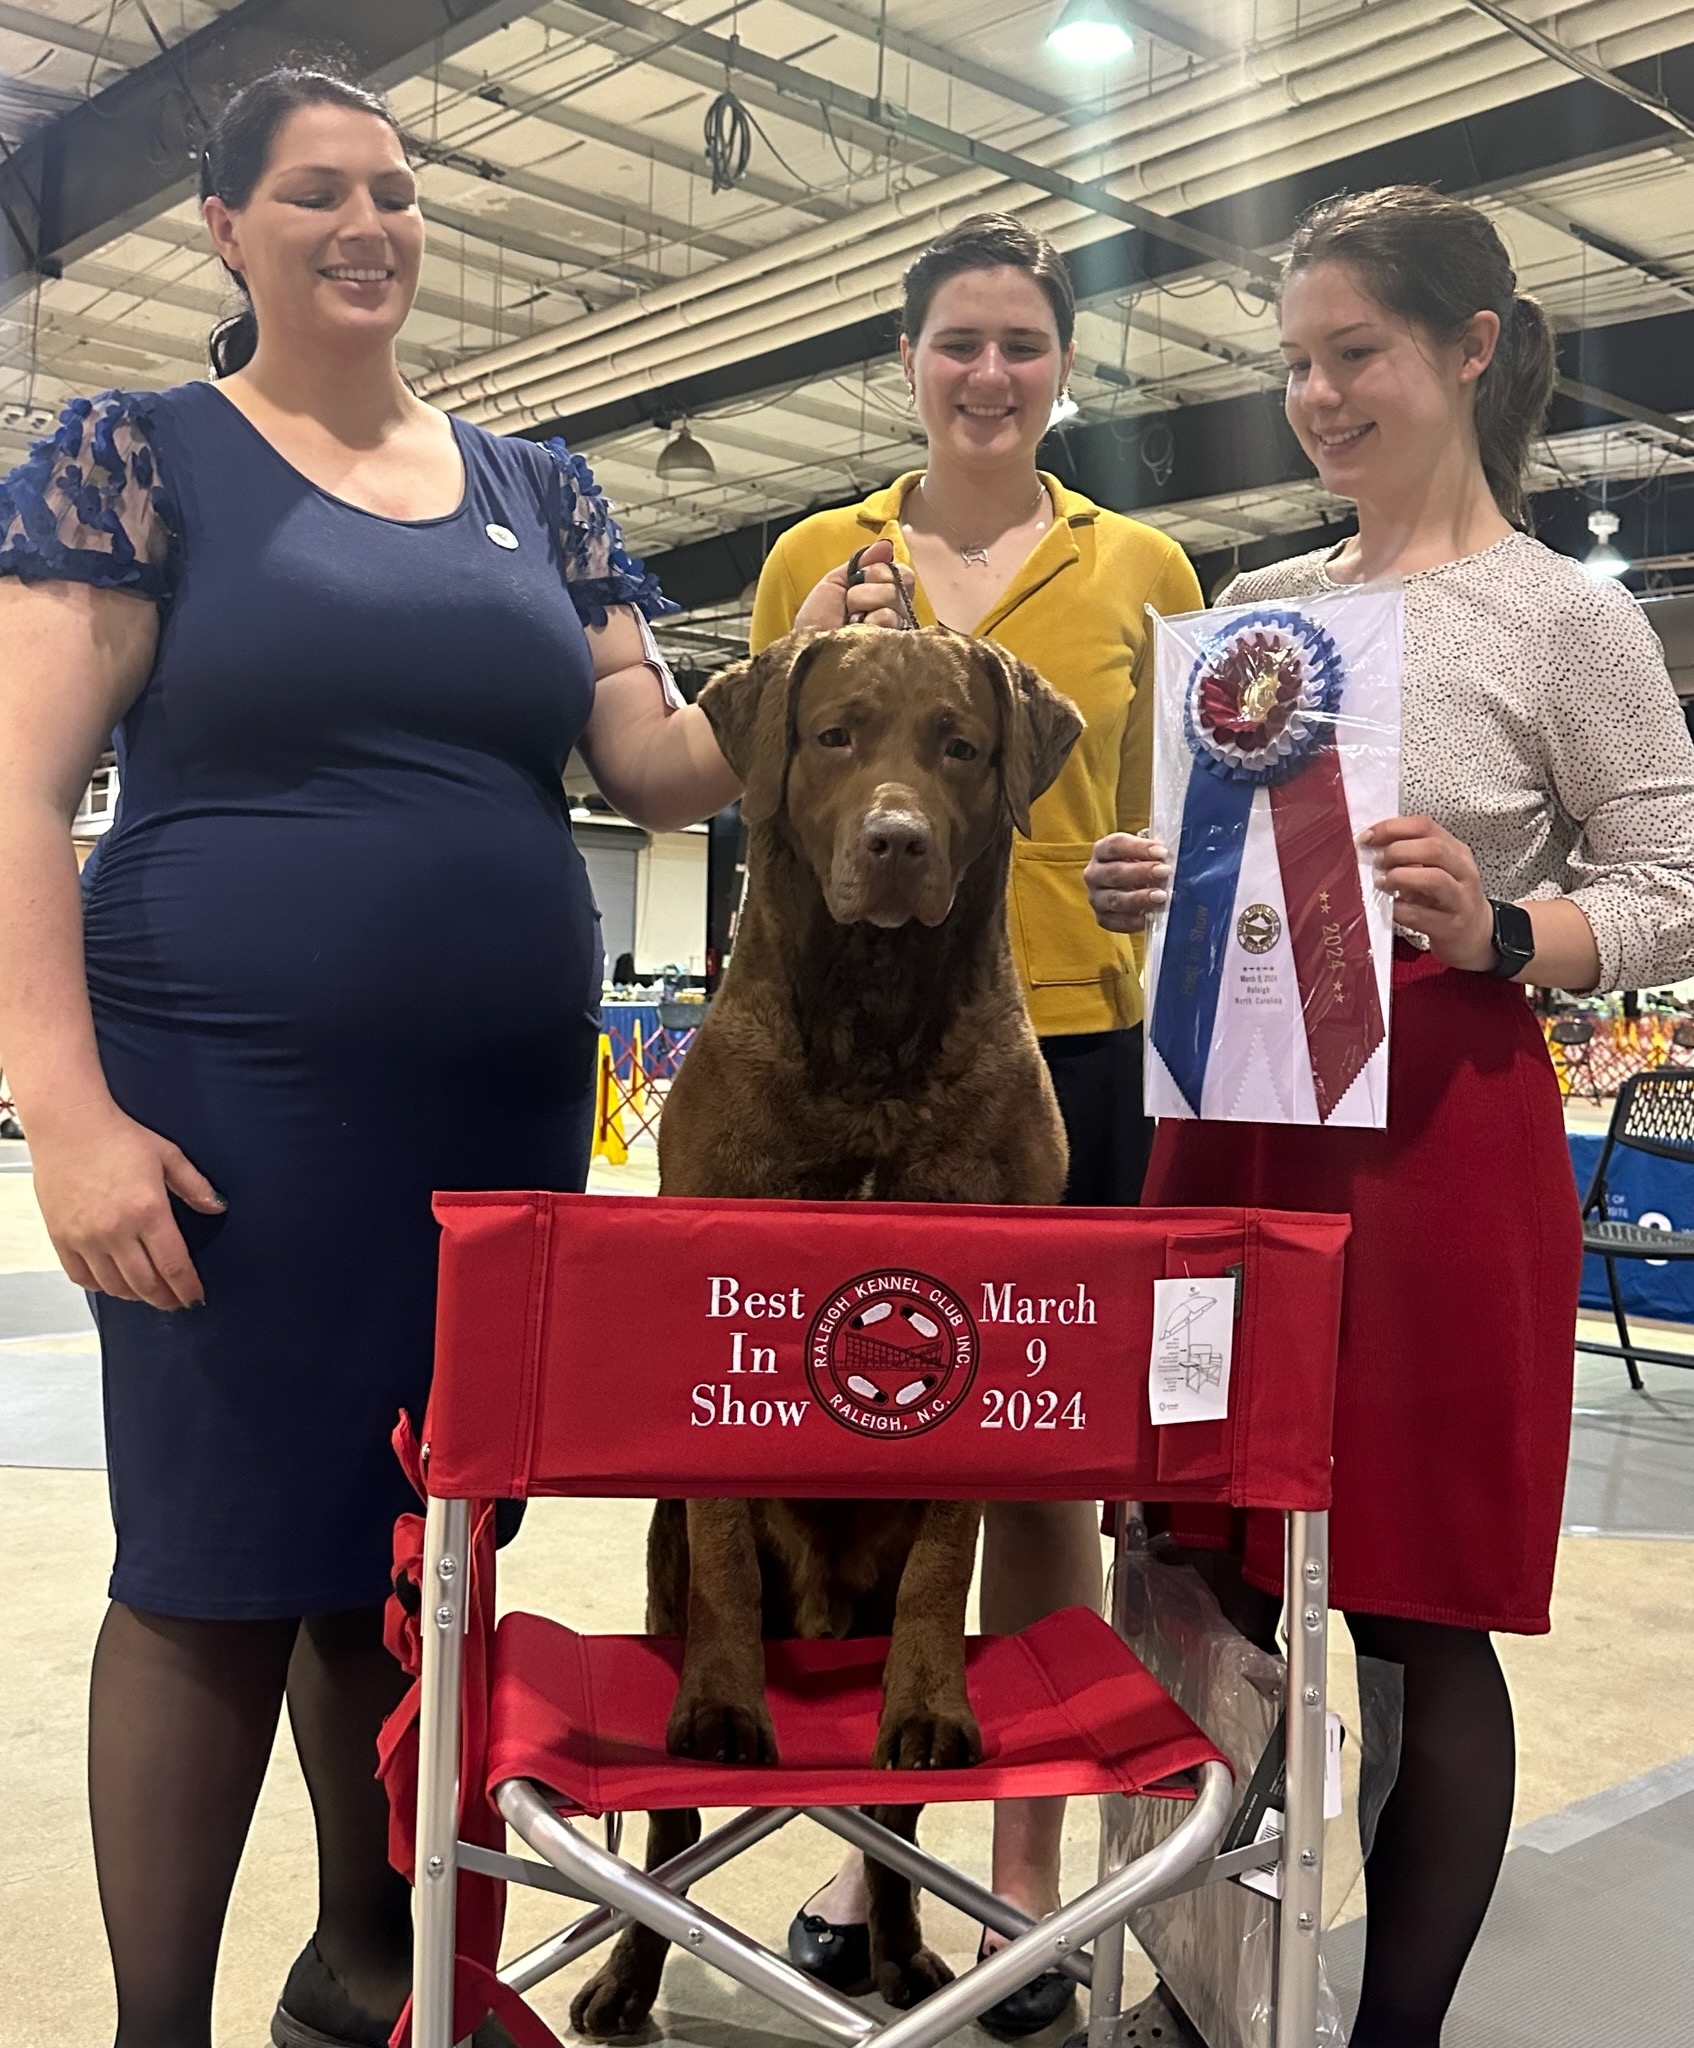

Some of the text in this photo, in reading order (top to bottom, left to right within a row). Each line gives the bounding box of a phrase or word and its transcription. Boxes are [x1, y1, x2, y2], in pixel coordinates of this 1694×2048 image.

[1322, 923, 1346, 970] 2024
[1246, 986, 1270, 995] Raleigh
[705, 1276, 806, 1320] Best
[978, 1282, 1098, 1325] March
[814, 1276, 971, 1369] RALEIGH KENNEL CLUB INC.
[726, 1332, 779, 1374] In
[1026, 1338, 1047, 1377] 9
[691, 1383, 811, 1427] Show
[829, 1393, 951, 1431] RALEIGH, N.C.
[980, 1389, 1087, 1431] 2024
